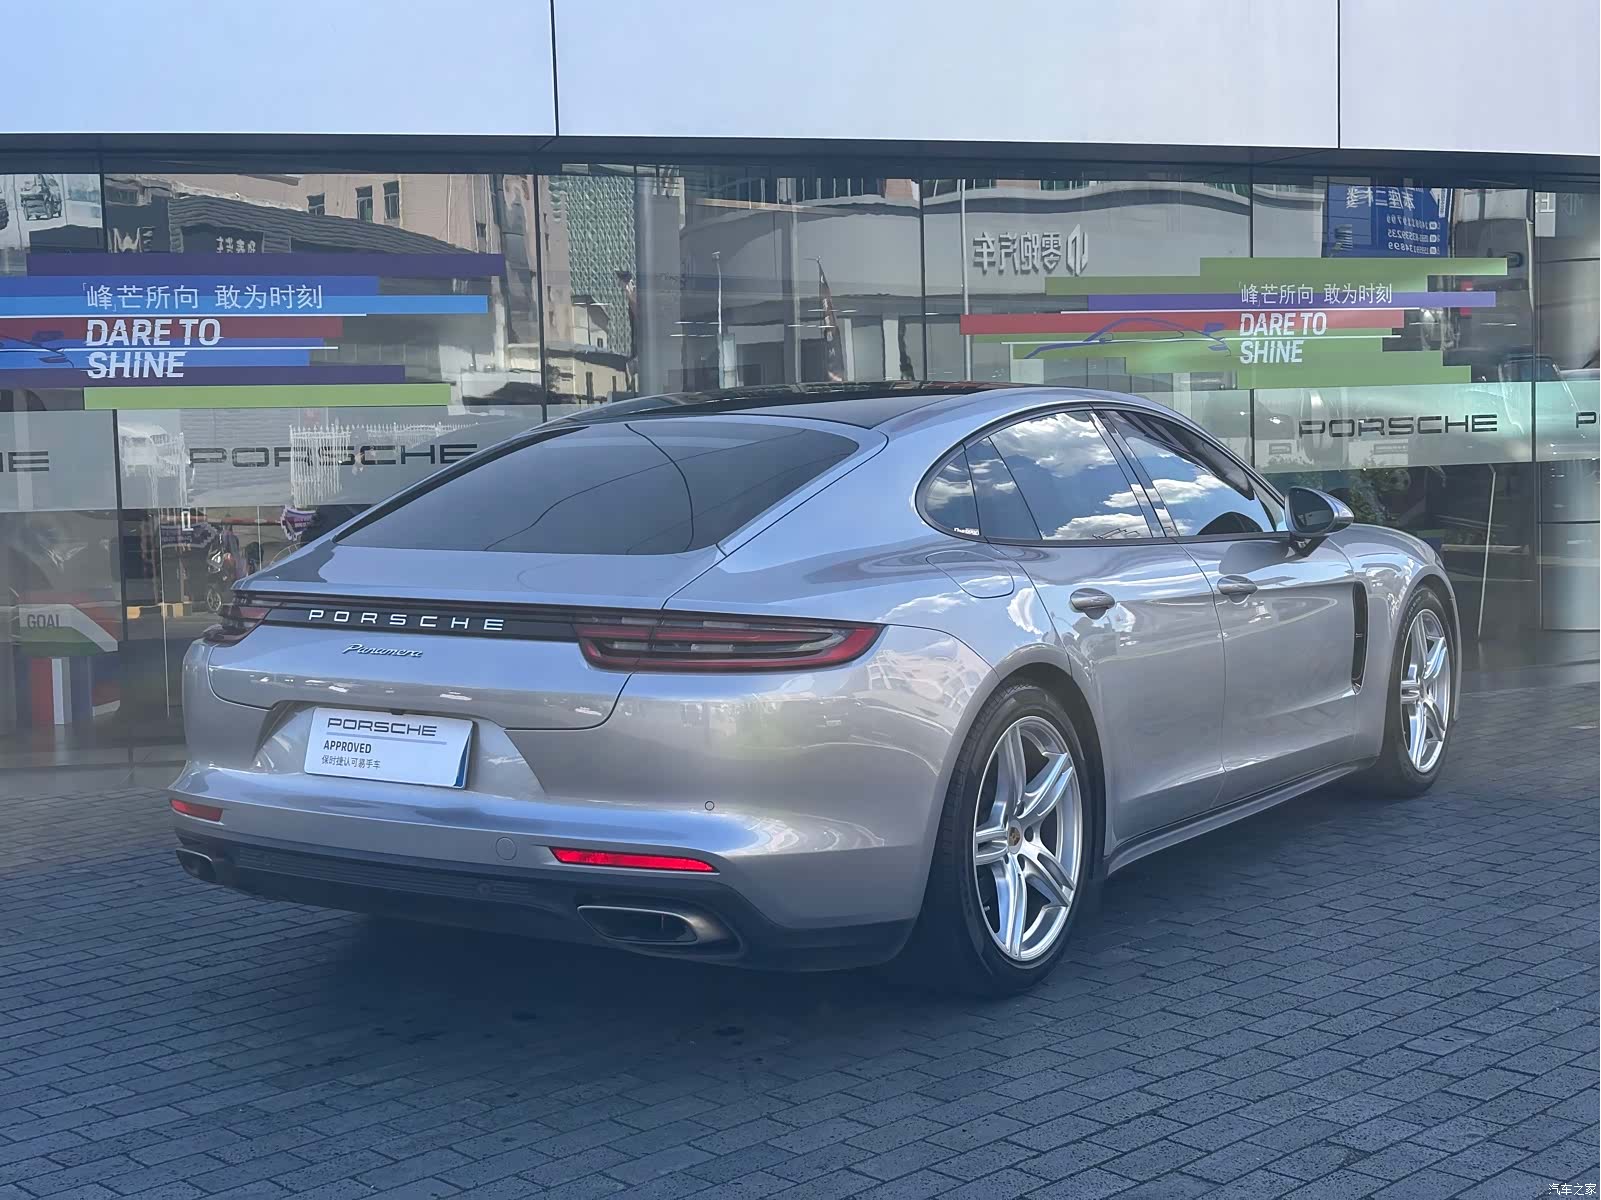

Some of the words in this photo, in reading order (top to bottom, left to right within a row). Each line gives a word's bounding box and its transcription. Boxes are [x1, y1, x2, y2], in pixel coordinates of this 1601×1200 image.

[214, 284, 323, 310] 敢为时刻
[1324, 283, 1392, 304] 敢为时刻
[85, 318, 172, 346] DARE
[179, 318, 222, 346] TO
[1240, 312, 1296, 336] DARE
[1300, 312, 1328, 335] TO
[1240, 340, 1304, 364] SHINE
[86, 351, 187, 379] SHINE
[1298, 414, 1497, 438] PORSCHE
[188, 443, 478, 468] PORSCHE
[308, 609, 505, 631] PORSCHE
[342, 643, 424, 658] Panamera
[327, 717, 438, 737] PORSCHE
[323, 740, 372, 754] APPROVED
[321, 755, 381, 769] 保时捷认可易手车
